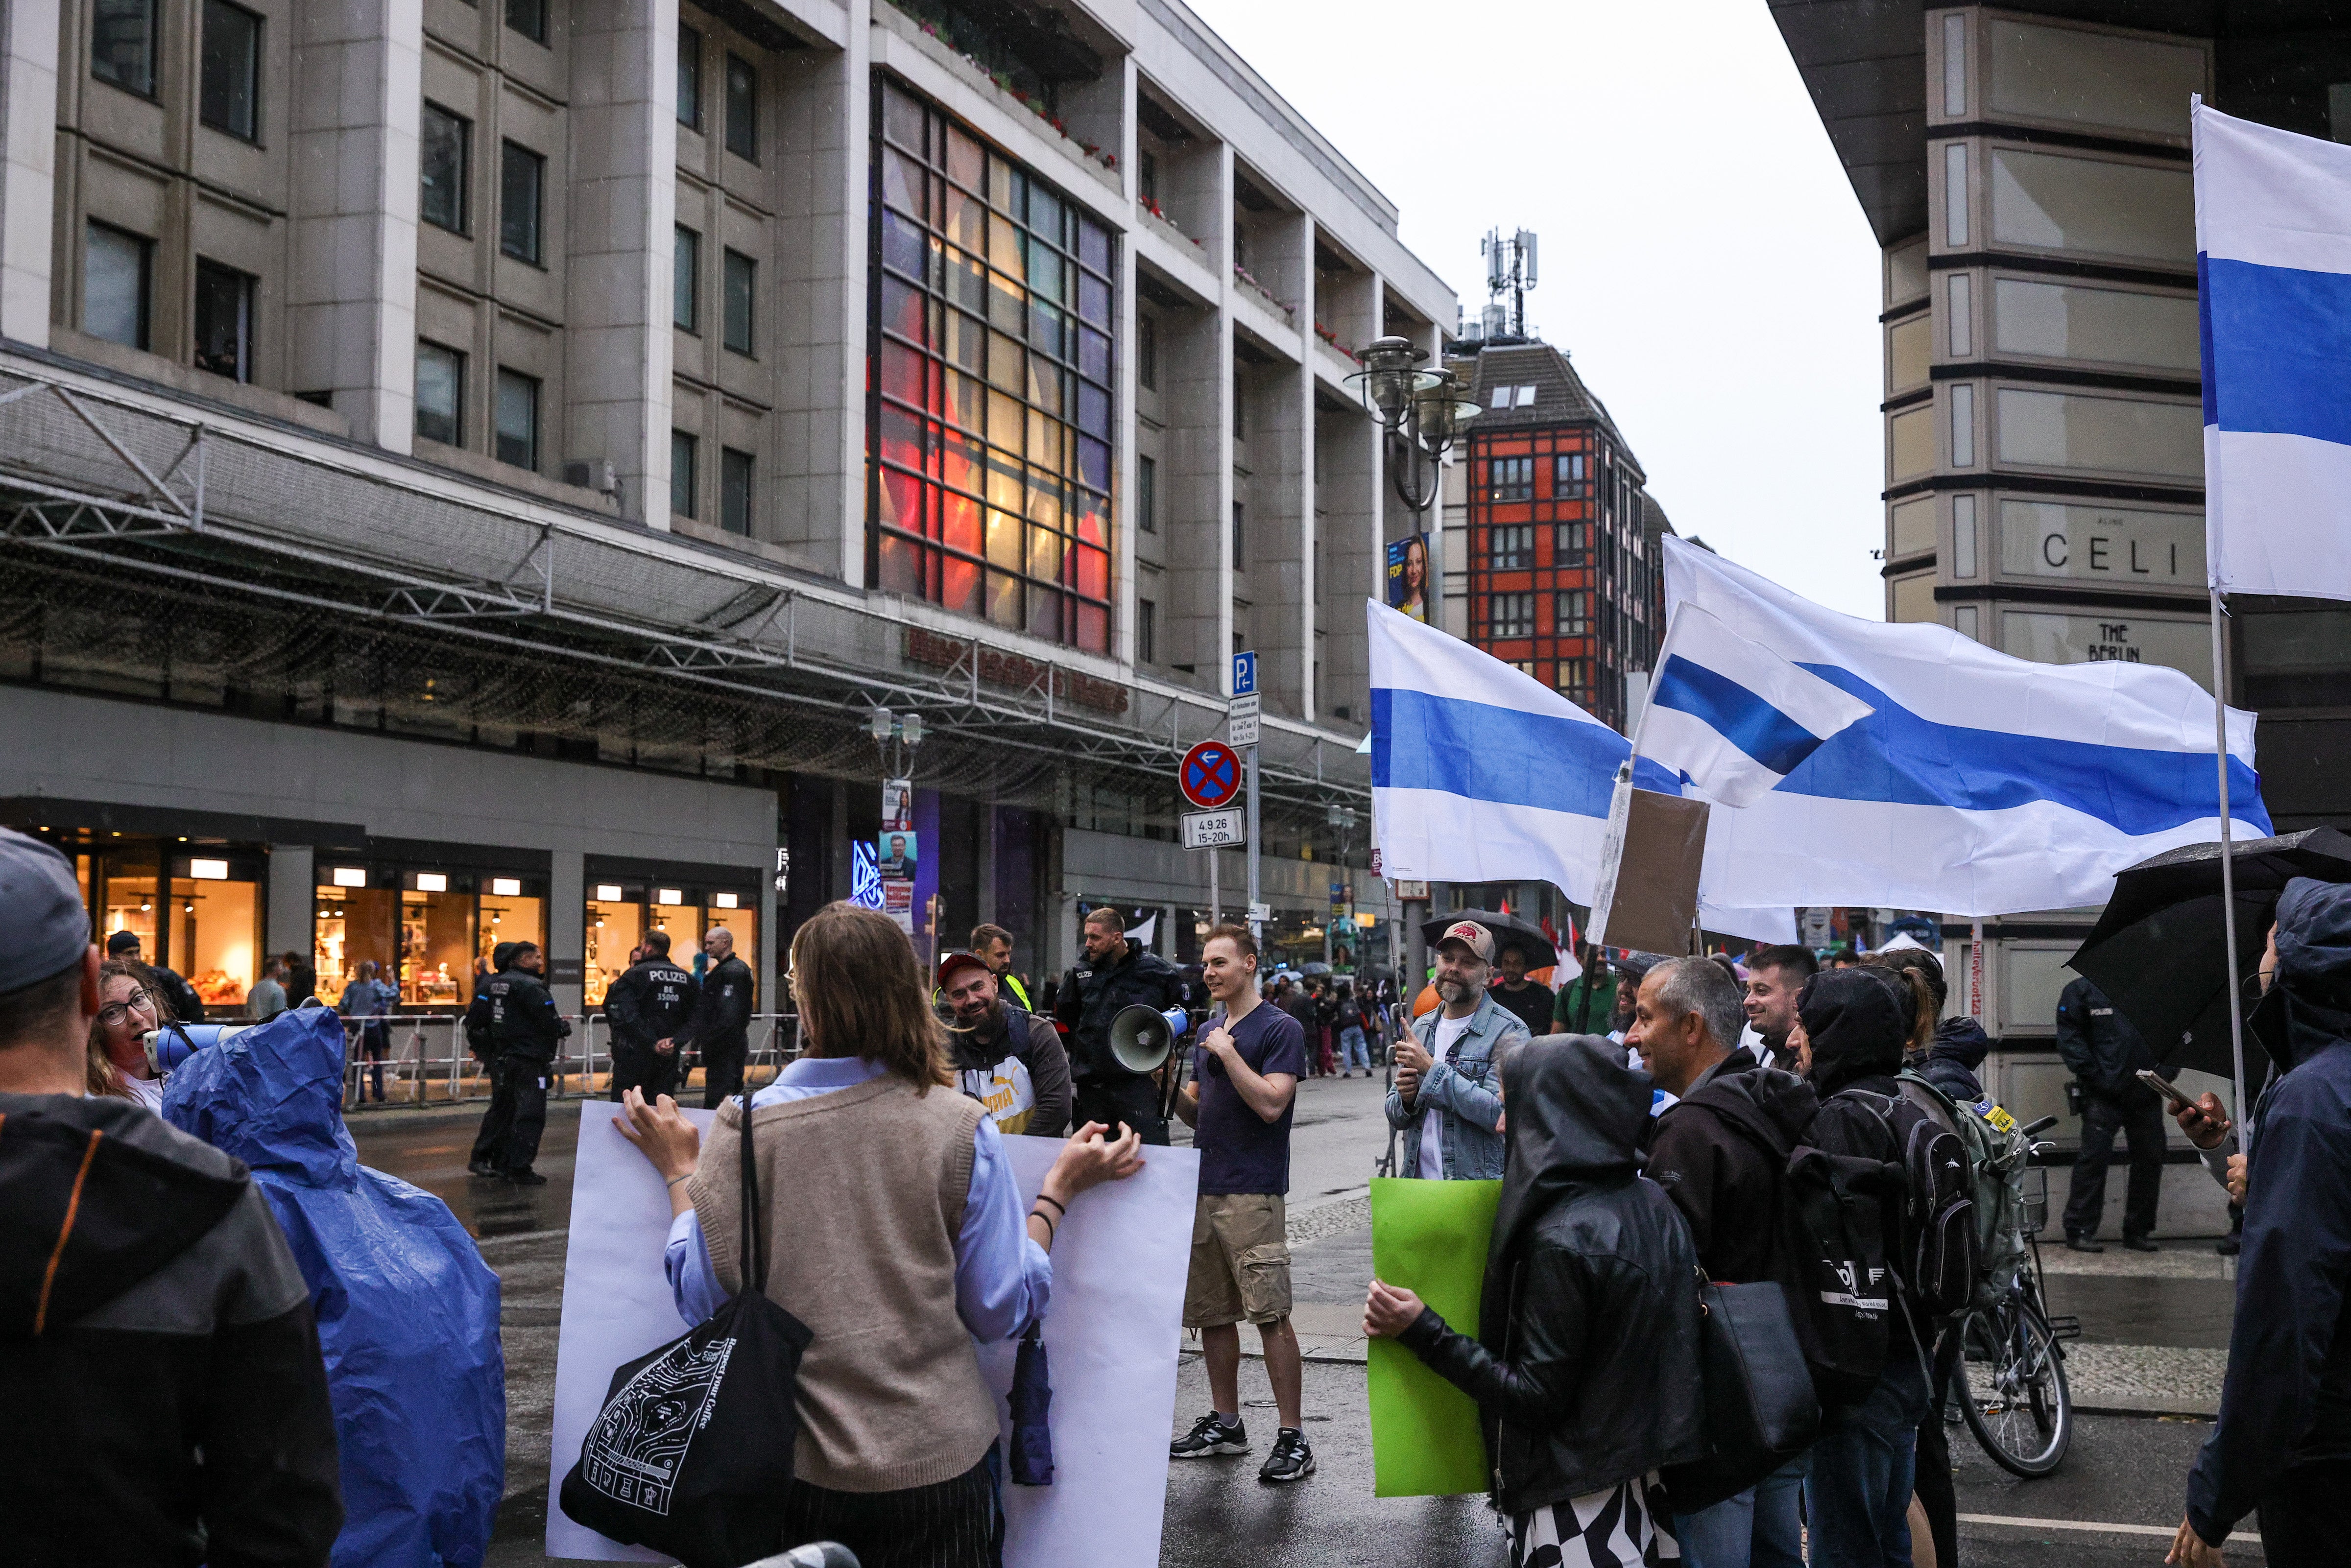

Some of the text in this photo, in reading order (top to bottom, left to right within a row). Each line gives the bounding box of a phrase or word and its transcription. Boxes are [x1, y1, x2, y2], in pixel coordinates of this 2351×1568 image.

[2043, 533, 2176, 575] CELI
[1389, 564, 1402, 578] FDP
[2099, 623, 2128, 642] THE
[2089, 644, 2139, 663] BERLIN
[1236, 658, 1247, 689] P
[1199, 819, 1227, 830] 4.9.26
[1198, 832, 1229, 843] 15-20h
[649, 970, 687, 983] POLIZEI
[698, 1337, 737, 1429] Respect your Coffee
